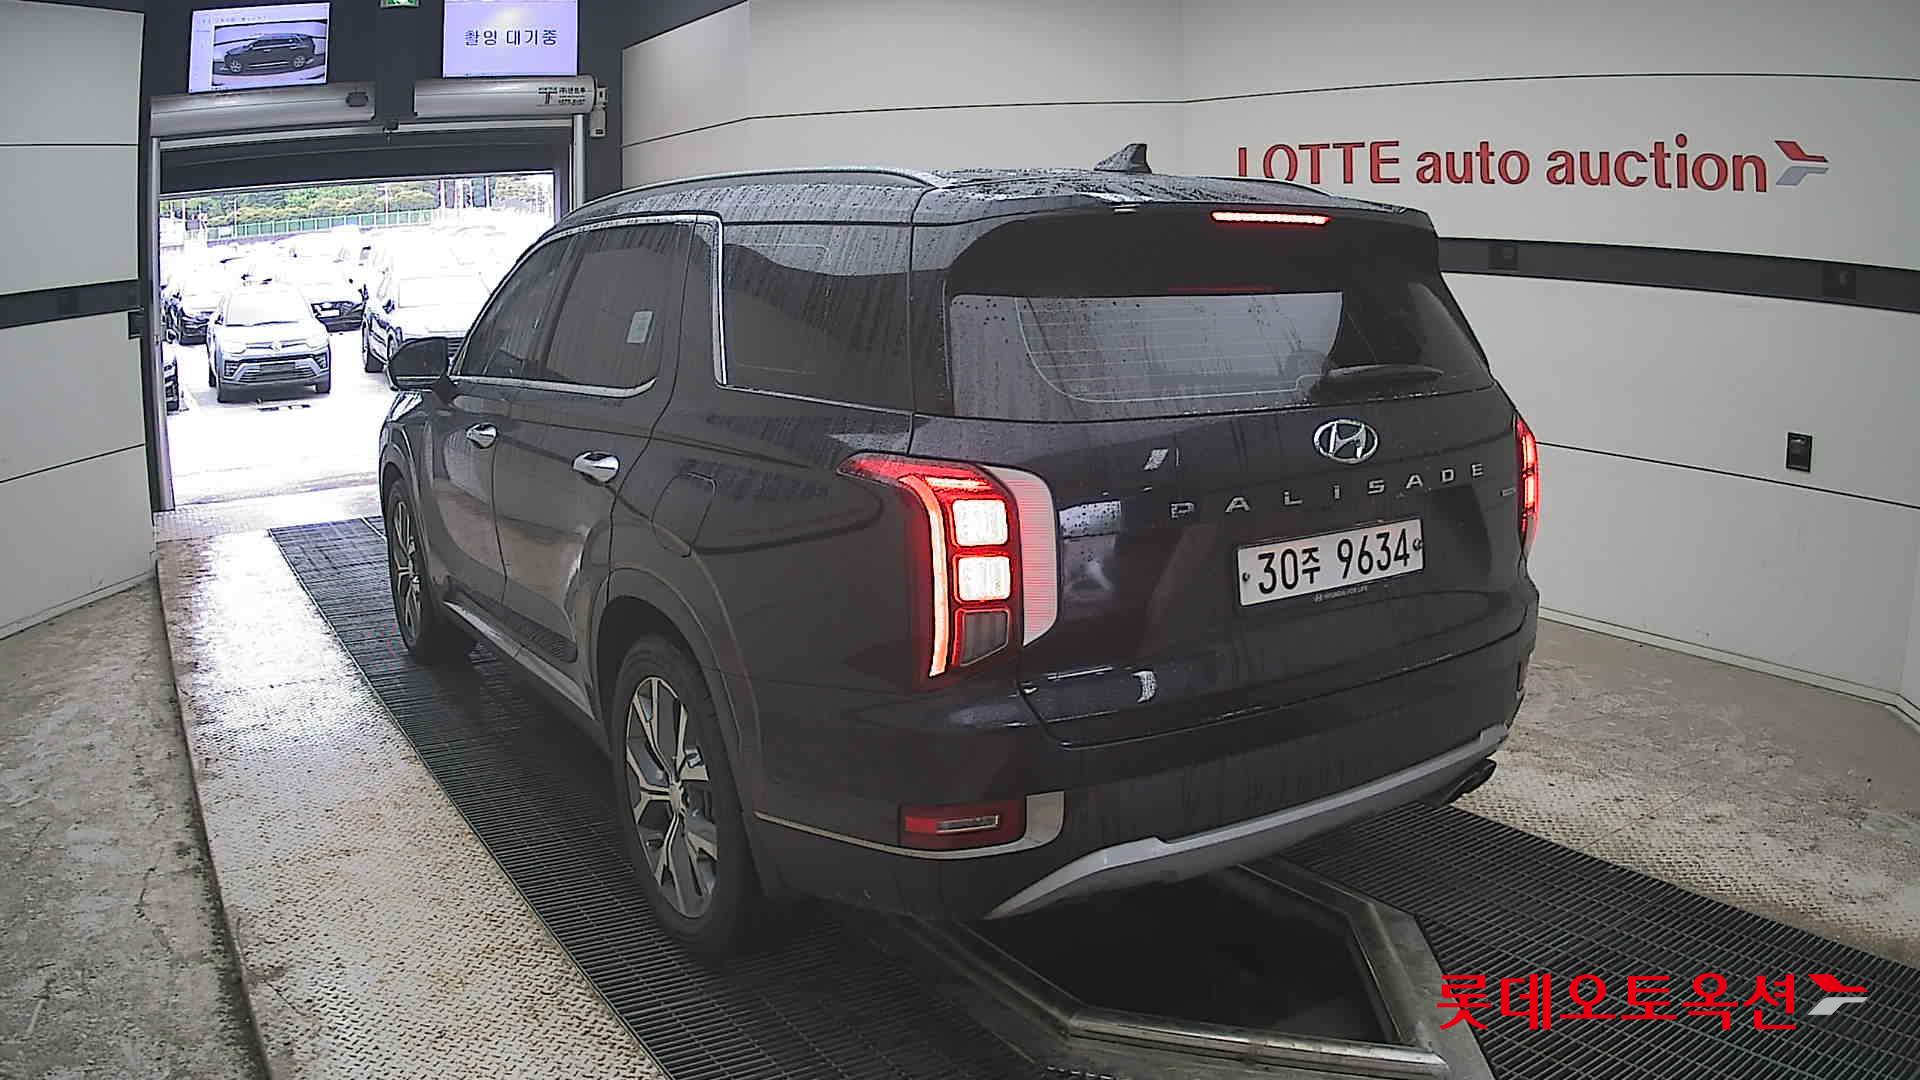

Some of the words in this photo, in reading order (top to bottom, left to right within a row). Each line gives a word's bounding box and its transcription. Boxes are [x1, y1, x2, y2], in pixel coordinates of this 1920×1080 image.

[506, 29, 557, 46] 대기중
[1415, 140, 1530, 186] auto
[1546, 133, 1767, 193] auction
[1169, 462, 1485, 519] PALISADE
[1257, 547, 1321, 595] 30주
[1337, 527, 1410, 580] 9634
